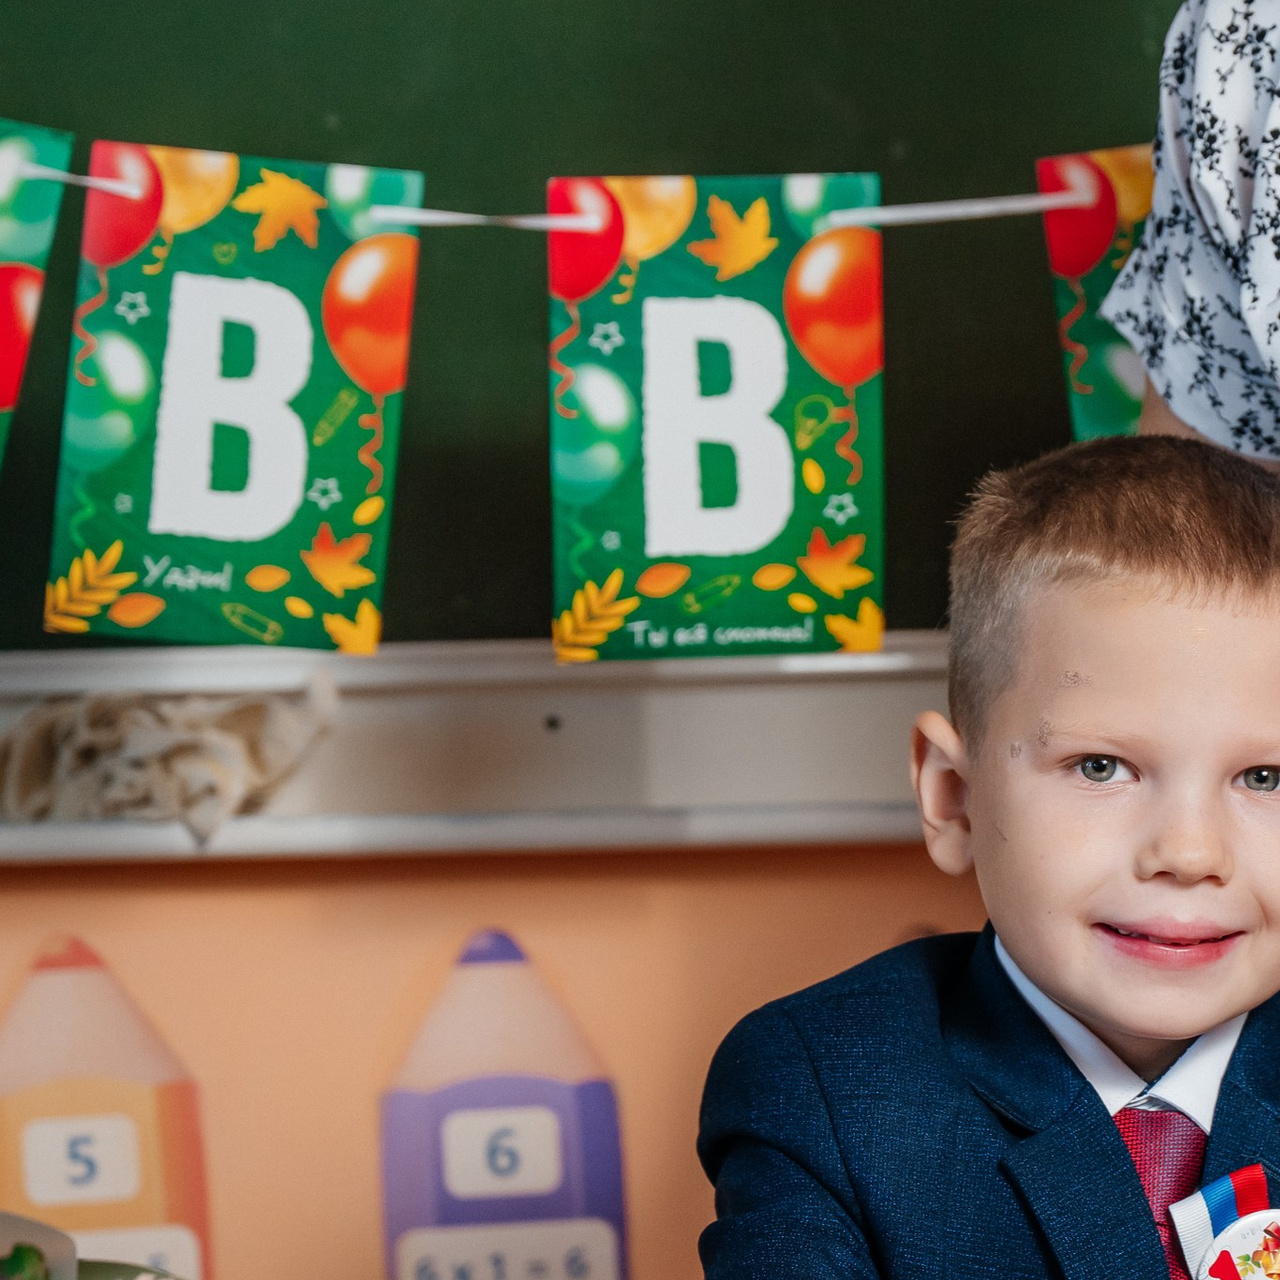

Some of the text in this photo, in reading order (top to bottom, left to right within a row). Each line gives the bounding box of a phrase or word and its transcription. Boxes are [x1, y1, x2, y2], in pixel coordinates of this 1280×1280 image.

[147, 271, 313, 541] В
[643, 294, 796, 558] В
[64, 1134, 100, 1187] 5
[485, 1127, 520, 1178] 6
